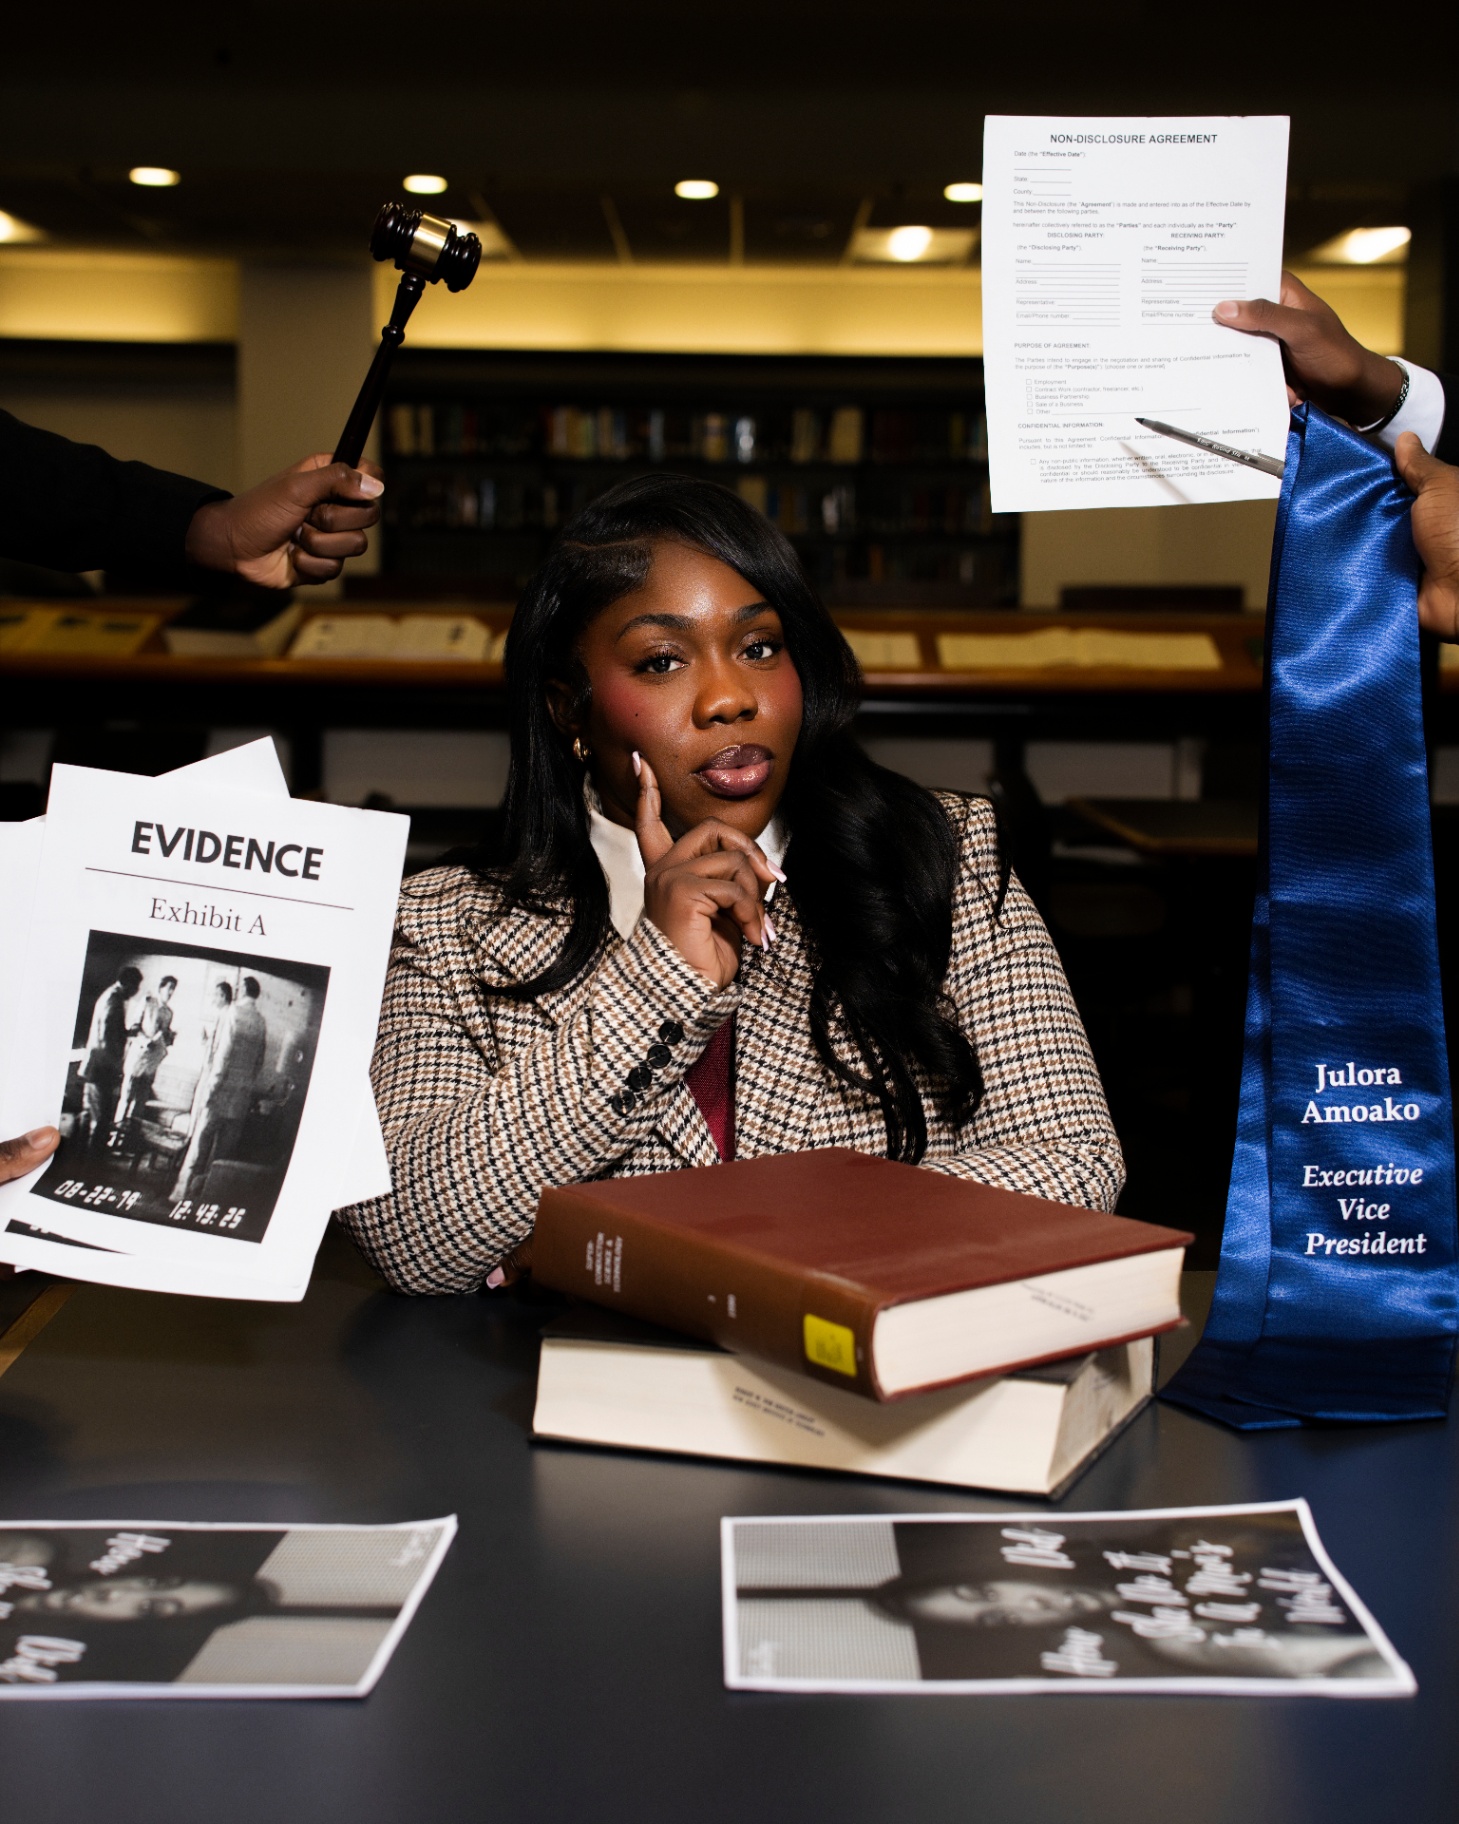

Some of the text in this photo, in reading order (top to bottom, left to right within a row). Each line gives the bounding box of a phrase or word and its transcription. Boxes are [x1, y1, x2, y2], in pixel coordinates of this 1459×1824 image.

[1050, 134, 1218, 144] NON-DISCLOSURE AGREEMENT
[131, 820, 324, 881] EVIDENCE
[149, 897, 267, 937] Exhibit A
[1315, 1062, 1402, 1093] Julora
[1301, 1097, 1420, 1124] Amoako
[1302, 1163, 1423, 1187] Executive
[1337, 1198, 1391, 1220] Vice
[1305, 1231, 1427, 1255] President
